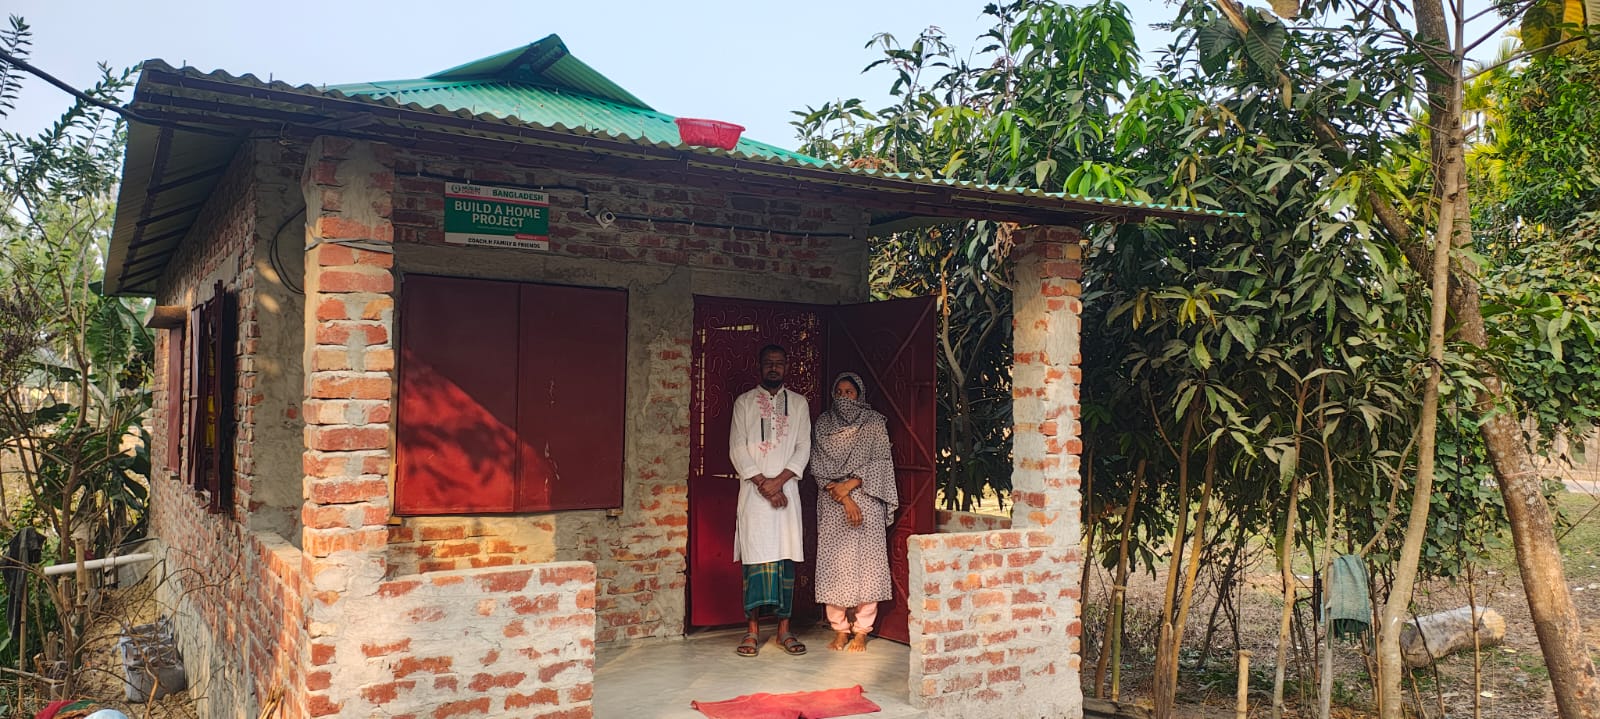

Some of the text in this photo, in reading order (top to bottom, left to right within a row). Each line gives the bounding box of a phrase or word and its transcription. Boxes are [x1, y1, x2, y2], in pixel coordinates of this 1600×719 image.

[492, 189, 544, 201] BANGLADESH
[454, 201, 541, 219] BUILD A HOME
[472, 214, 524, 227] PROJECT
